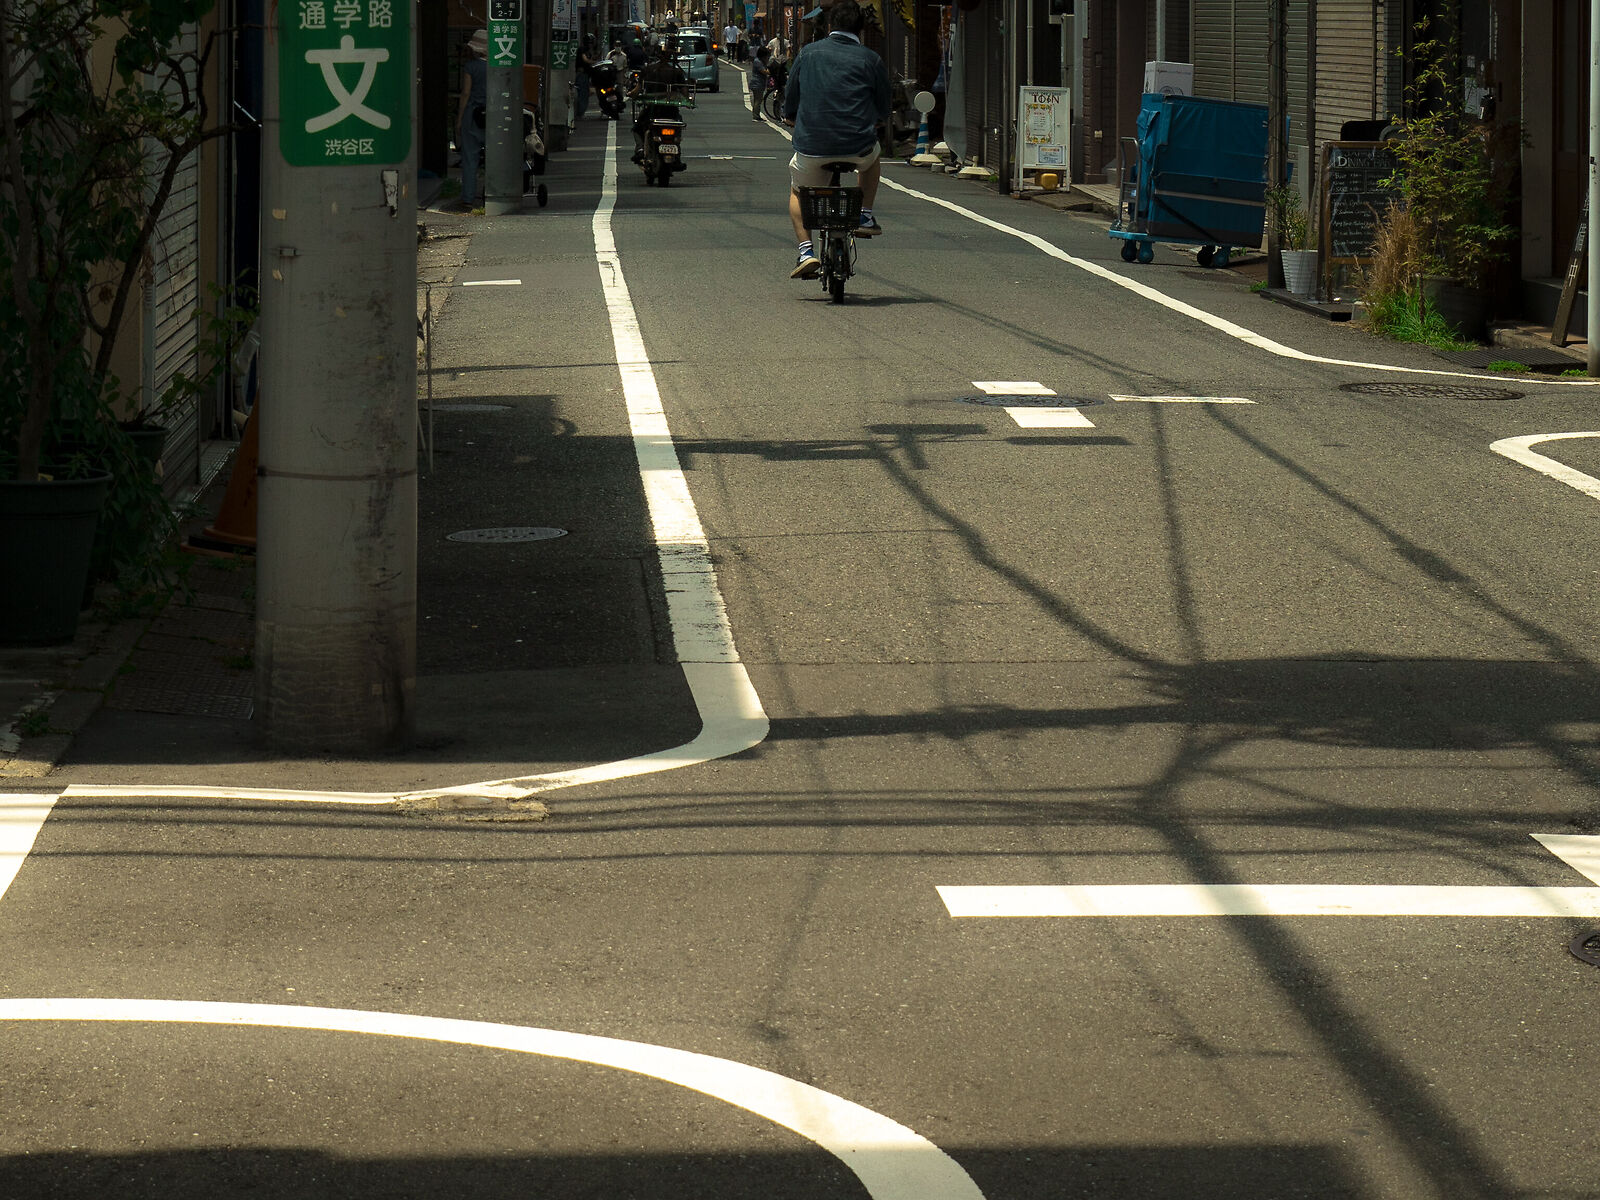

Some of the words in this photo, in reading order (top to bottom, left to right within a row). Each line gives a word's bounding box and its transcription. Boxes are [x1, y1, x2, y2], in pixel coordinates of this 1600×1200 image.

[299, 0, 393, 29] 通学路
[492, 25, 519, 34] 通学路
[494, 34, 517, 59] 文
[304, 34, 392, 133] 文
[325, 139, 375, 156] 渋谷区
